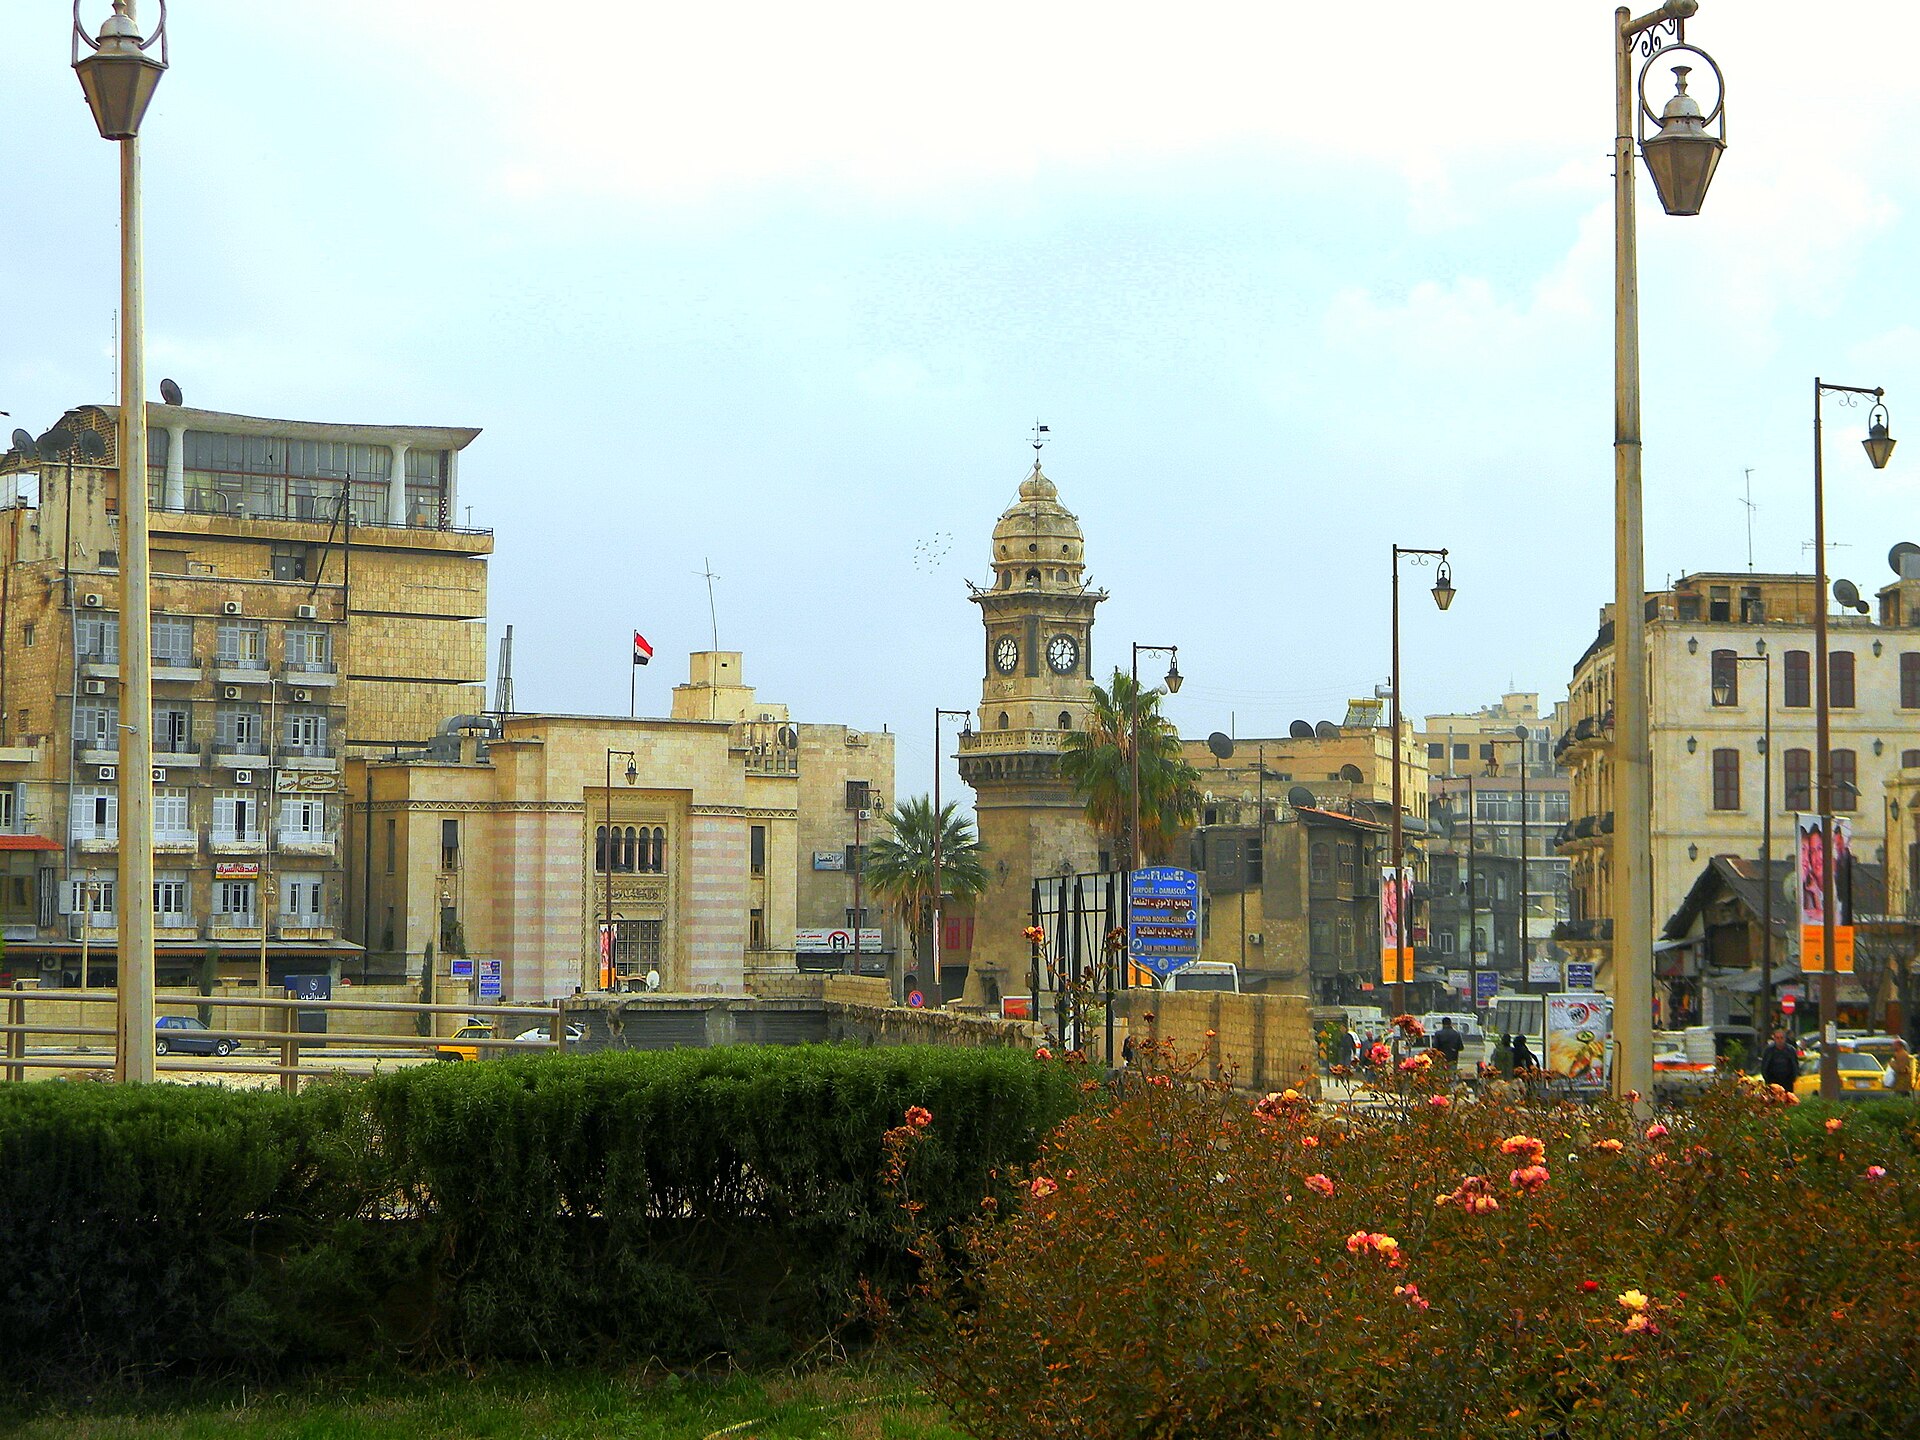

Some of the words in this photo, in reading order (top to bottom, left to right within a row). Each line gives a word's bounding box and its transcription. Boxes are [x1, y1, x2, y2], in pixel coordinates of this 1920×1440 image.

[215, 863, 240, 875] الشرق
[238, 863, 258, 873] فندق
[1159, 887, 1187, 895] DAMASCUS
[1174, 899, 1192, 909] الجامع
[1157, 927, 1168, 938] باب
[1184, 927, 1194, 939] باب
[300, 992, 327, 1001] شيراتون
